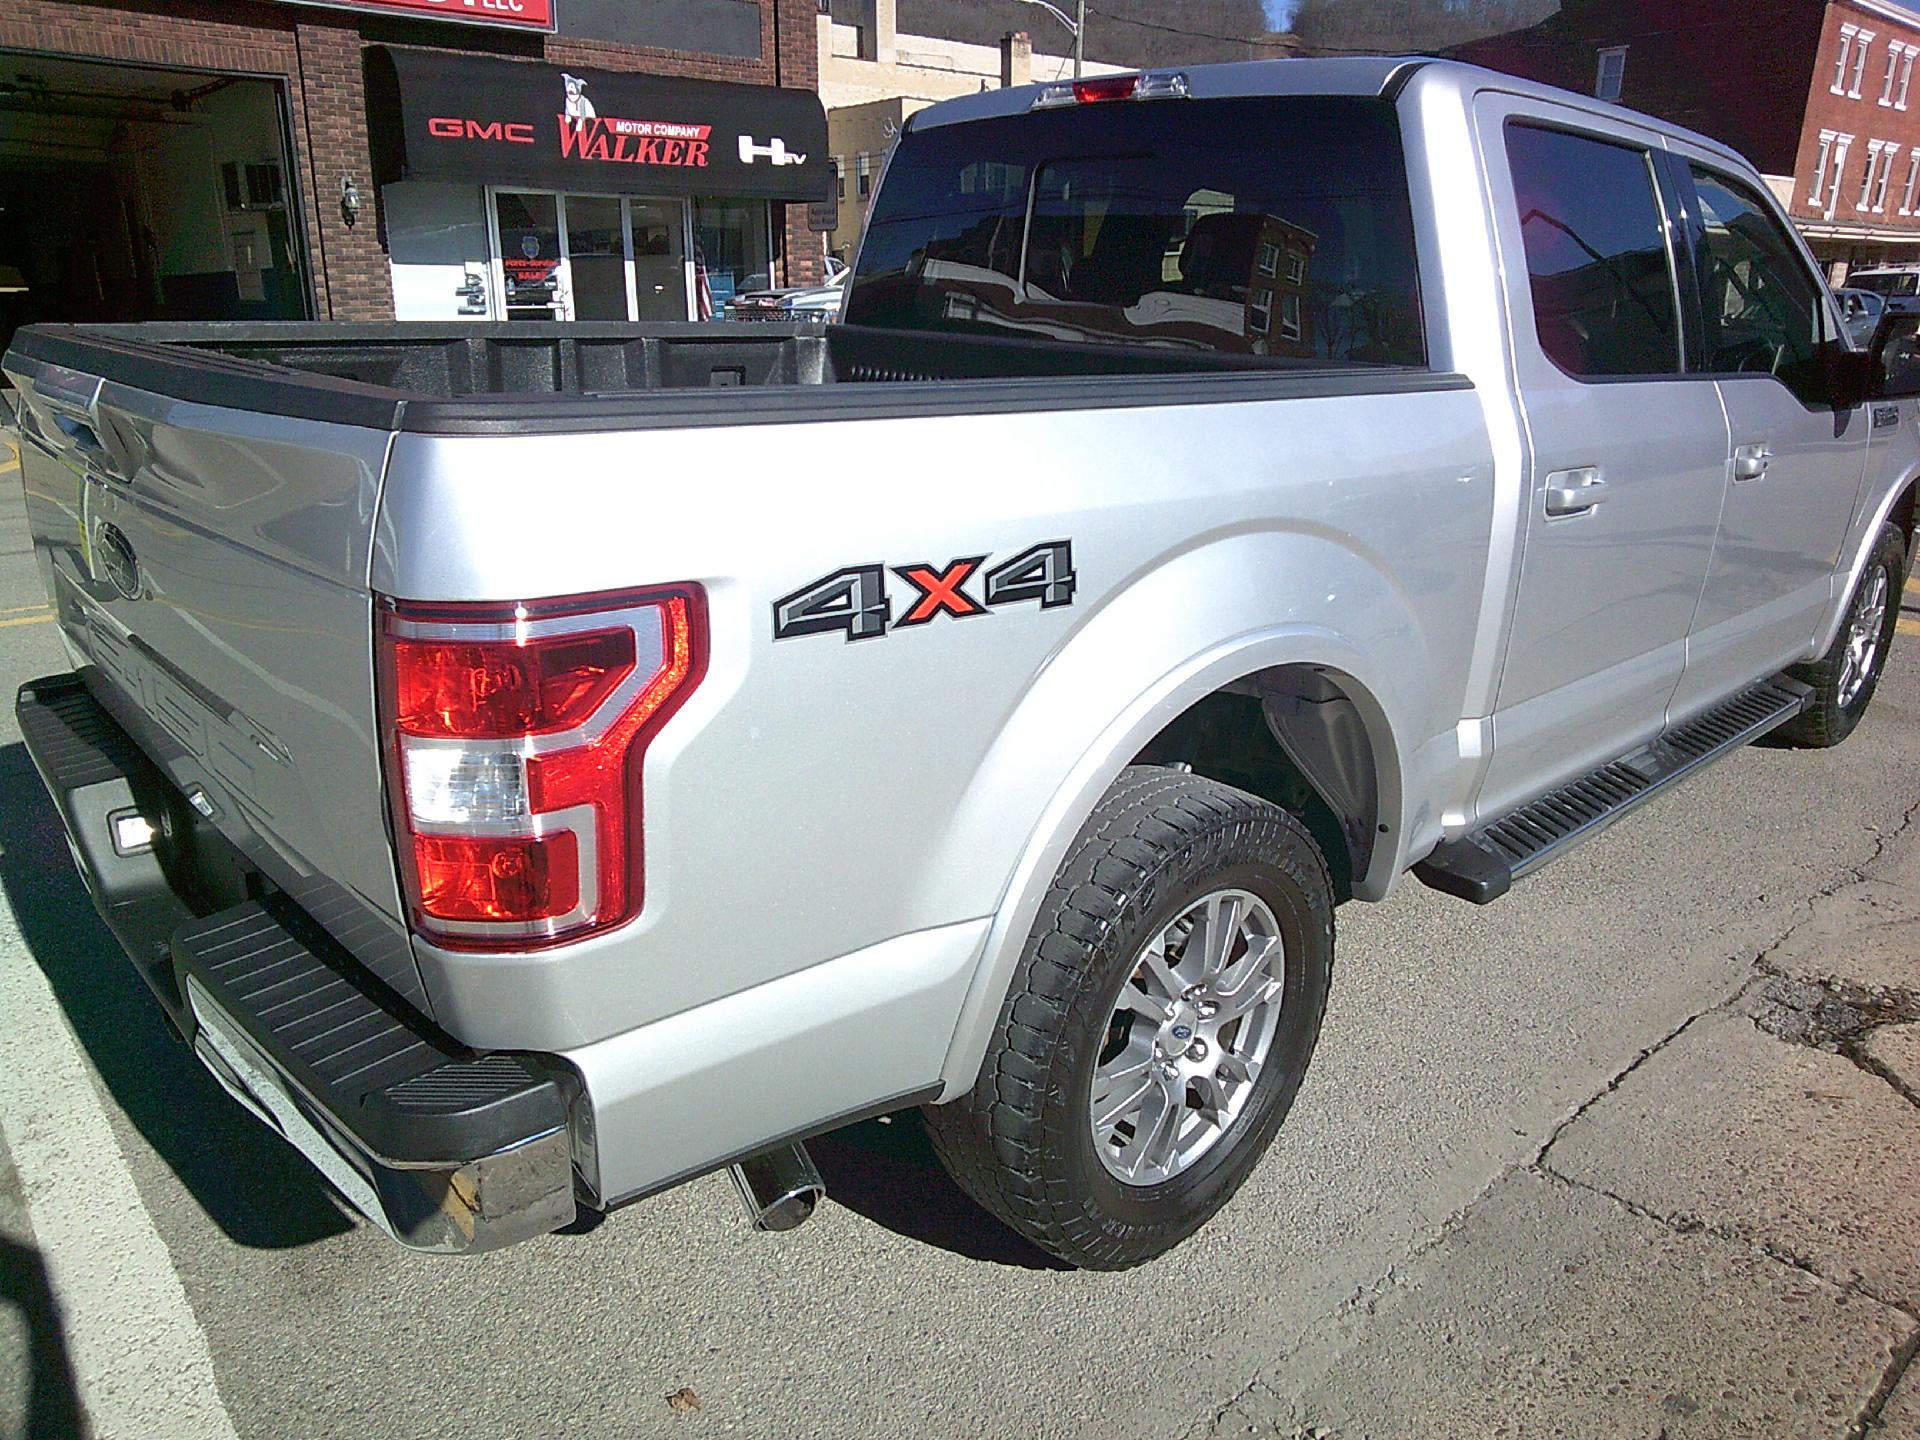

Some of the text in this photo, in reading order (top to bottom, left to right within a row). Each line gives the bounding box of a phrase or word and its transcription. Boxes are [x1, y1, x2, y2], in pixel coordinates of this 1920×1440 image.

[428, 117, 535, 143] GMC
[556, 114, 710, 167] WALKER
[616, 121, 701, 138] MOTOR COMPANY
